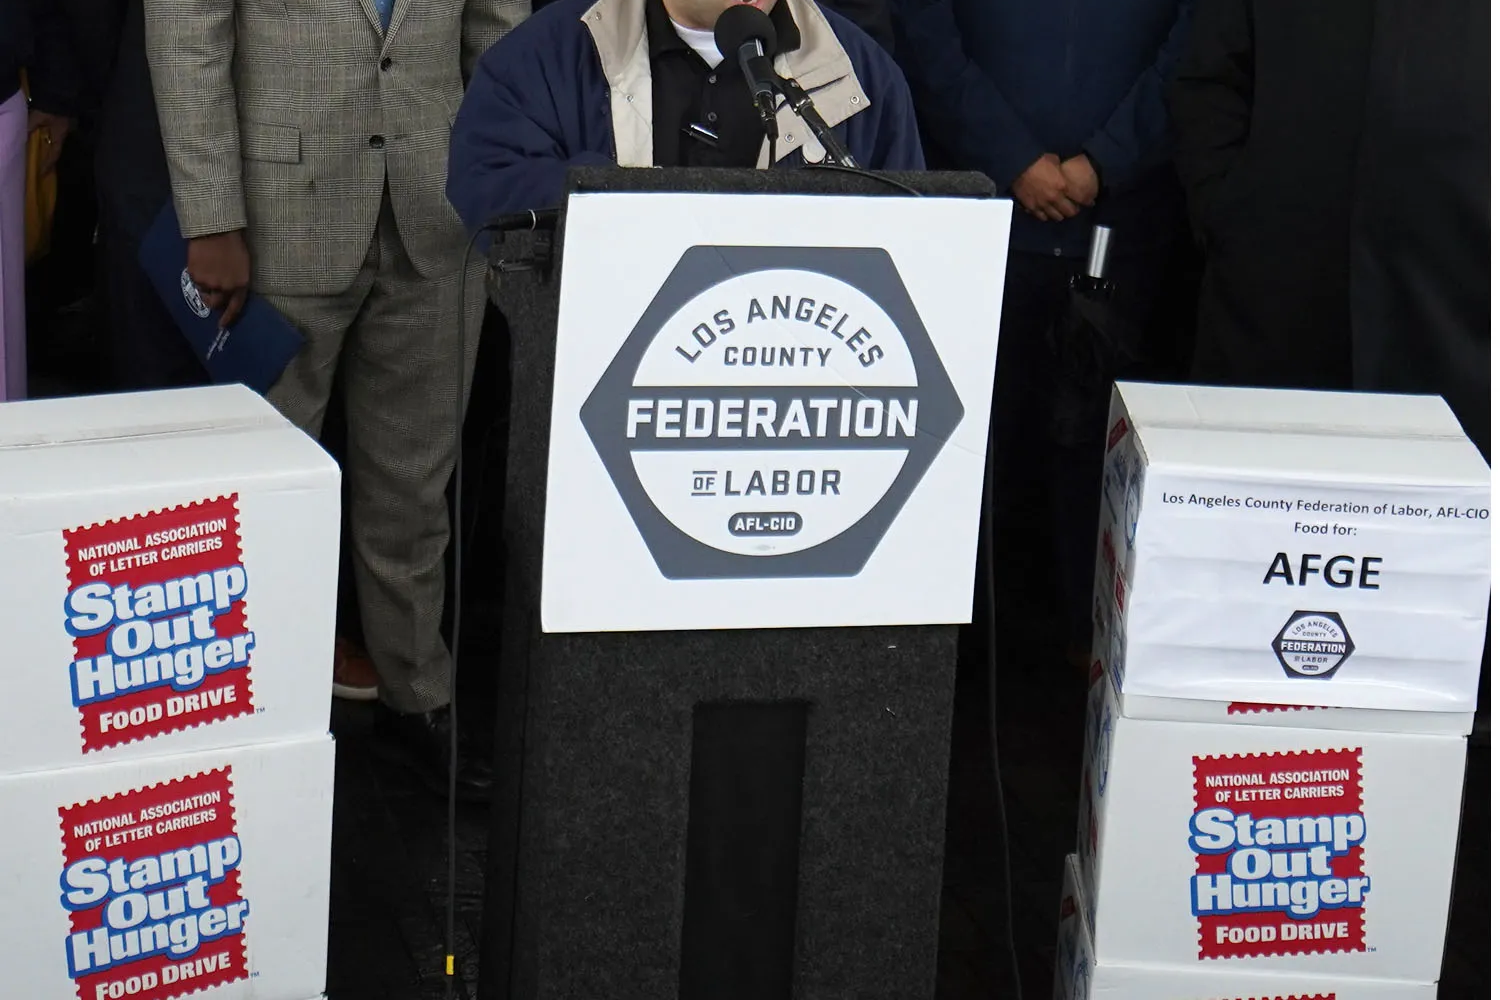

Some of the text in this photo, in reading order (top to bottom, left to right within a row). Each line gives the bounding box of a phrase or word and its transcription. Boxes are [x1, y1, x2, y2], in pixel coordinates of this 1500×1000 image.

[675, 295, 885, 368] LOS ANGELES
[724, 346, 832, 367] COUNTY
[626, 398, 918, 438] FEDERATION
[692, 470, 842, 497] OF LABOR
[734, 516, 796, 531] AFL-CIO
[1162, 491, 1489, 520] Los Angeles County Federation of Labor, AFL-CIO
[78, 518, 227, 562] NATIONAL ASSOCIATION
[1294, 521, 1357, 536] Food for:
[89, 537, 223, 577] OF LETTER CARRIERS
[1262, 551, 1383, 590] AFGE
[68, 565, 247, 632] Stamp
[112, 606, 216, 657] Out
[1281, 641, 1346, 653] FEDERATION
[1307, 620, 1338, 638] ANGELES
[75, 633, 253, 701] Hunger
[1301, 655, 1328, 663] LABOR
[99, 685, 237, 733] FOOD DRIVE
[1205, 769, 1349, 787] NATIONAL ASSOCIATION
[1215, 785, 1344, 803] OF LETTER CARRIERS
[74, 790, 221, 838] NATIONAL ASSOCIATION
[85, 809, 217, 852] OF LETTER CARRIERS
[1194, 808, 1365, 851] Stamp
[65, 837, 240, 904] Stamp
[1231, 845, 1331, 880] Out
[107, 876, 210, 930] Out
[1196, 876, 1369, 915] Hunger
[72, 902, 247, 972] Hunger
[1216, 921, 1349, 944] FOOD DRIVE
[96, 951, 232, 1000] FOOD DRIVE
